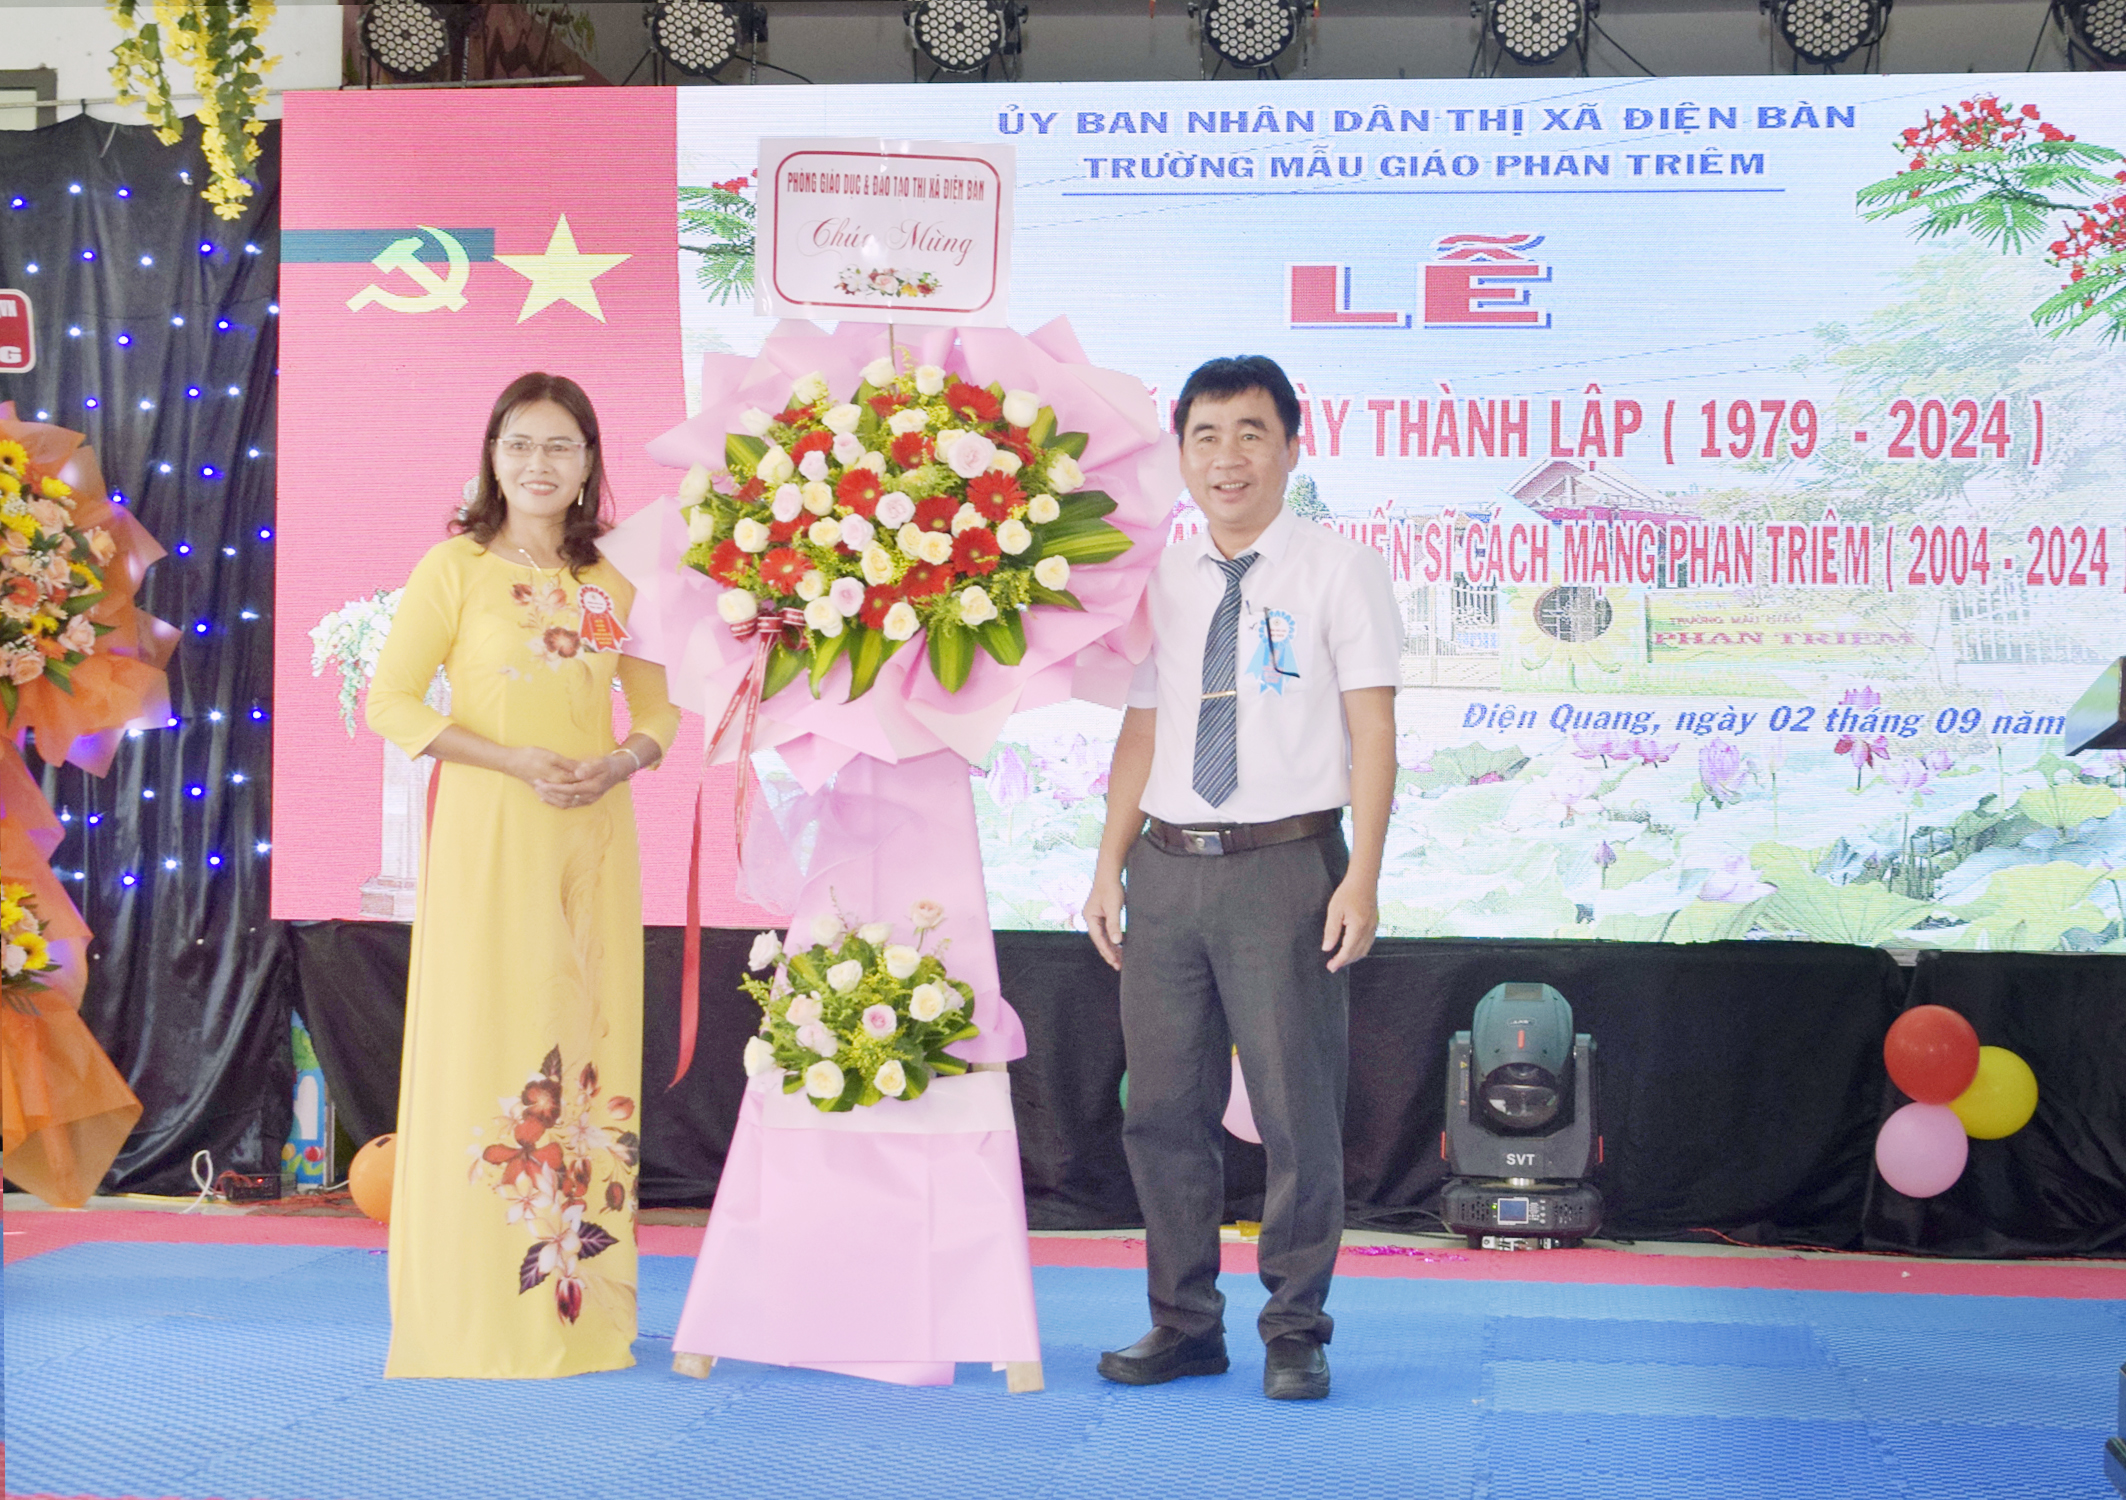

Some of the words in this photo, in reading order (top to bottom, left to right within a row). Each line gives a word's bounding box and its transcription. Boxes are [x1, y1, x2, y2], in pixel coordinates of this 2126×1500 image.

[998, 104, 1058, 134] ỦY
[1077, 110, 1168, 134] BAN
[1188, 105, 1314, 133] NHÂN
[1334, 105, 1430, 133] DÂN
[1447, 108, 1523, 136] THỊ
[1542, 103, 1603, 131] XÃ
[1624, 102, 1738, 134] ĐIỆN
[1757, 101, 1857, 130] BÀN
[1083, 150, 1254, 179] TRƯỜNG
[1270, 145, 1363, 178] MẪU
[1380, 149, 1479, 178] GIÁO
[1496, 154, 1609, 177] PHAN
[1626, 147, 1766, 176] TRIÊM
[863, 175, 870, 195] &
[1290, 234, 1552, 329] LỄ
[1368, 383, 1528, 458] THÀNH
[1550, 383, 1643, 471] LẬP
[1700, 399, 1818, 459] 1979
[1888, 399, 2011, 459] 2024
[1424, 508, 1452, 583] SĨ
[1466, 507, 1549, 583] CÁCH
[1564, 523, 1655, 597] MẠNG
[1669, 525, 1753, 584] PHAN
[1766, 509, 1870, 584] TRIÊM
[1908, 525, 1990, 586] 2004
[2026, 525, 2109, 586] 2024
[1654, 631, 1764, 645] PHAN
[1462, 702, 1537, 734] Điện
[1550, 703, 1661, 735] Quang,
[1675, 705, 1758, 736] ngày
[1768, 705, 1816, 732] 02
[1824, 706, 1925, 738] tháng
[1934, 707, 1982, 734] 09
[1991, 710, 2066, 735] năm
[1506, 1154, 1535, 1166] SVT
